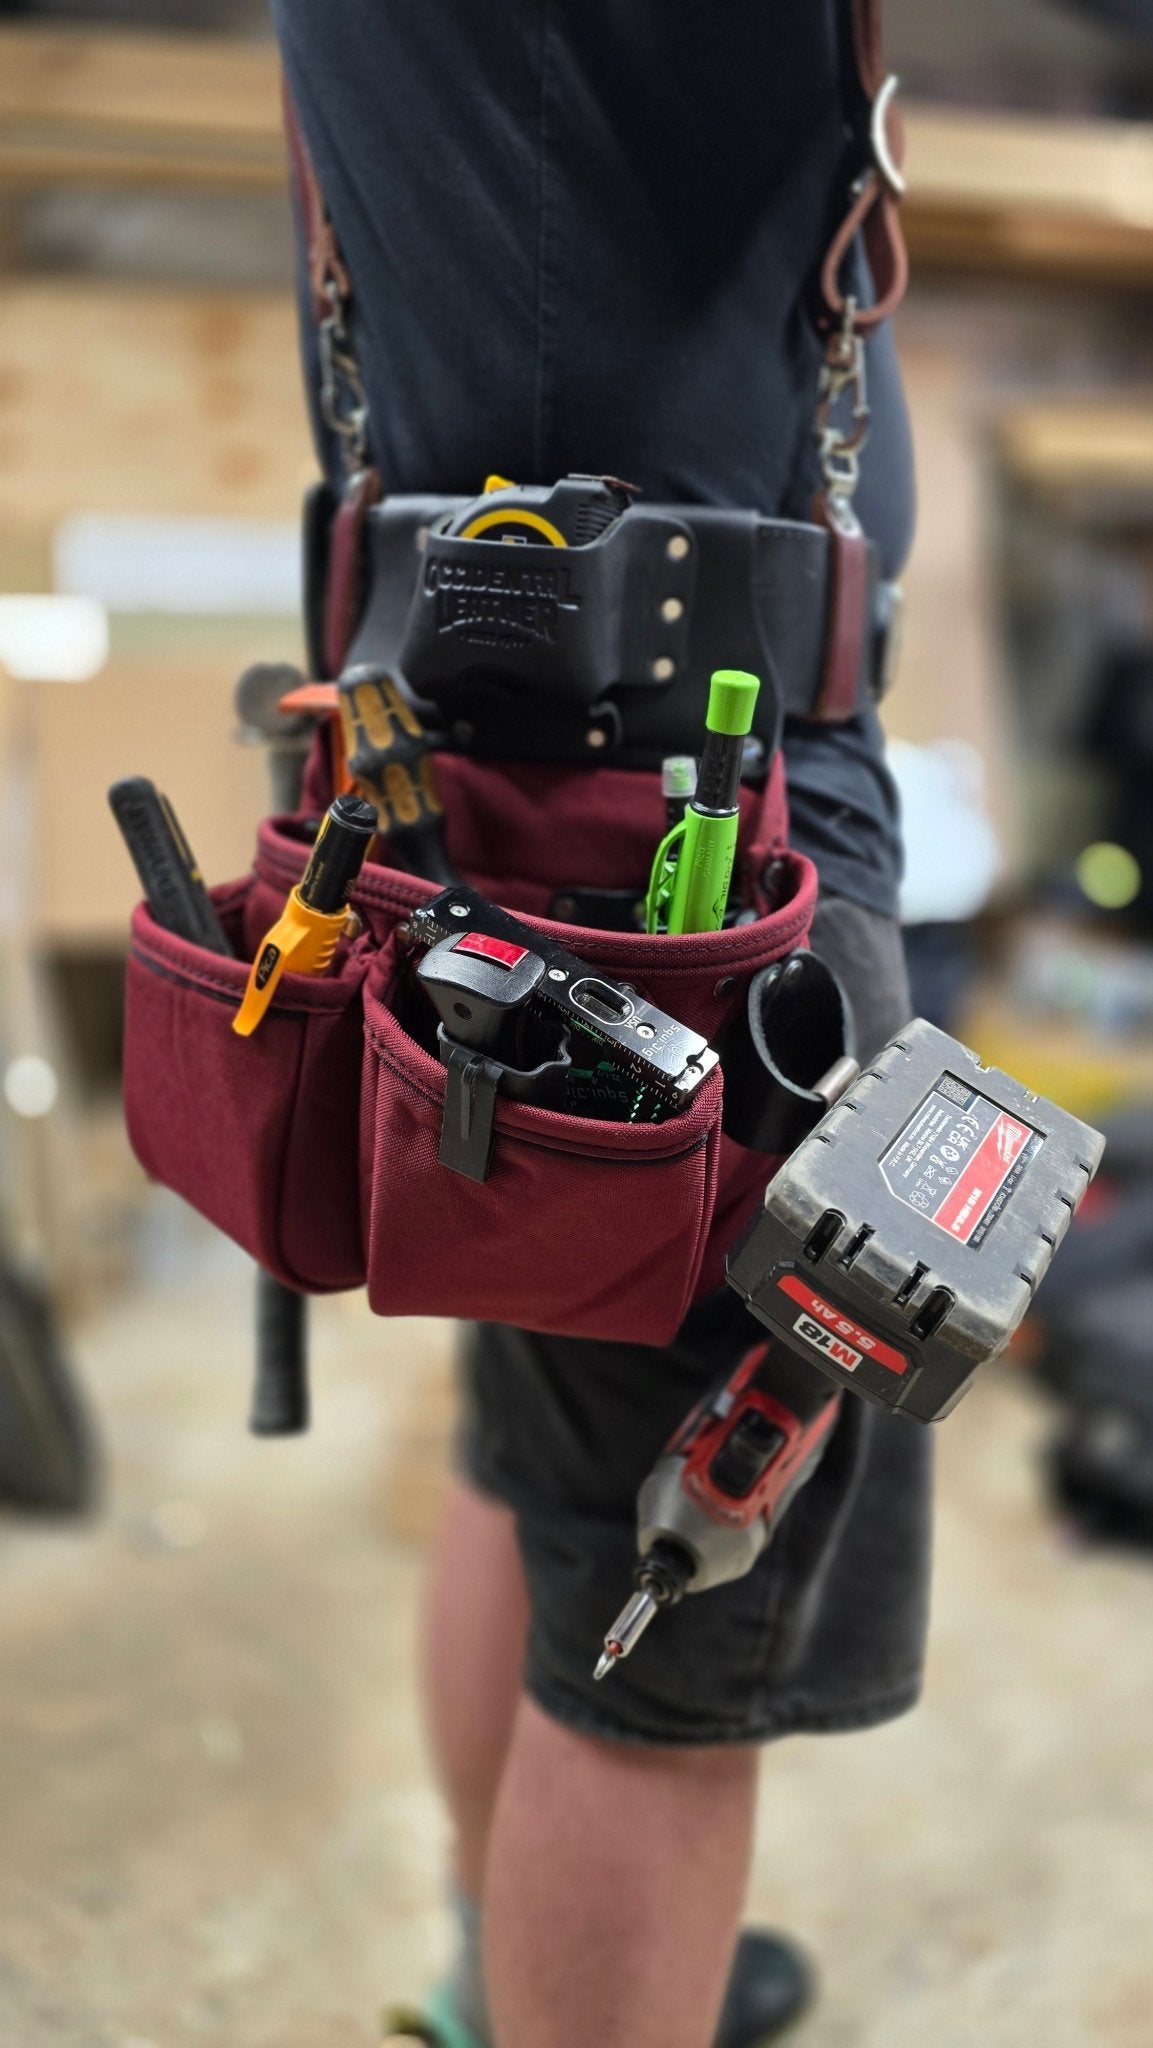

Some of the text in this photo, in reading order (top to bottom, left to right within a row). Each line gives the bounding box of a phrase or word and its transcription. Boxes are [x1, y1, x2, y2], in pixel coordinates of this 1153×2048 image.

[424, 557, 581, 609] OCCIDENTAL
[438, 595, 554, 642] LEATHER
[955, 1135, 970, 1150] UK
[796, 1319, 857, 1367] M18
[810, 1299, 876, 1350] 5.5 Ah
